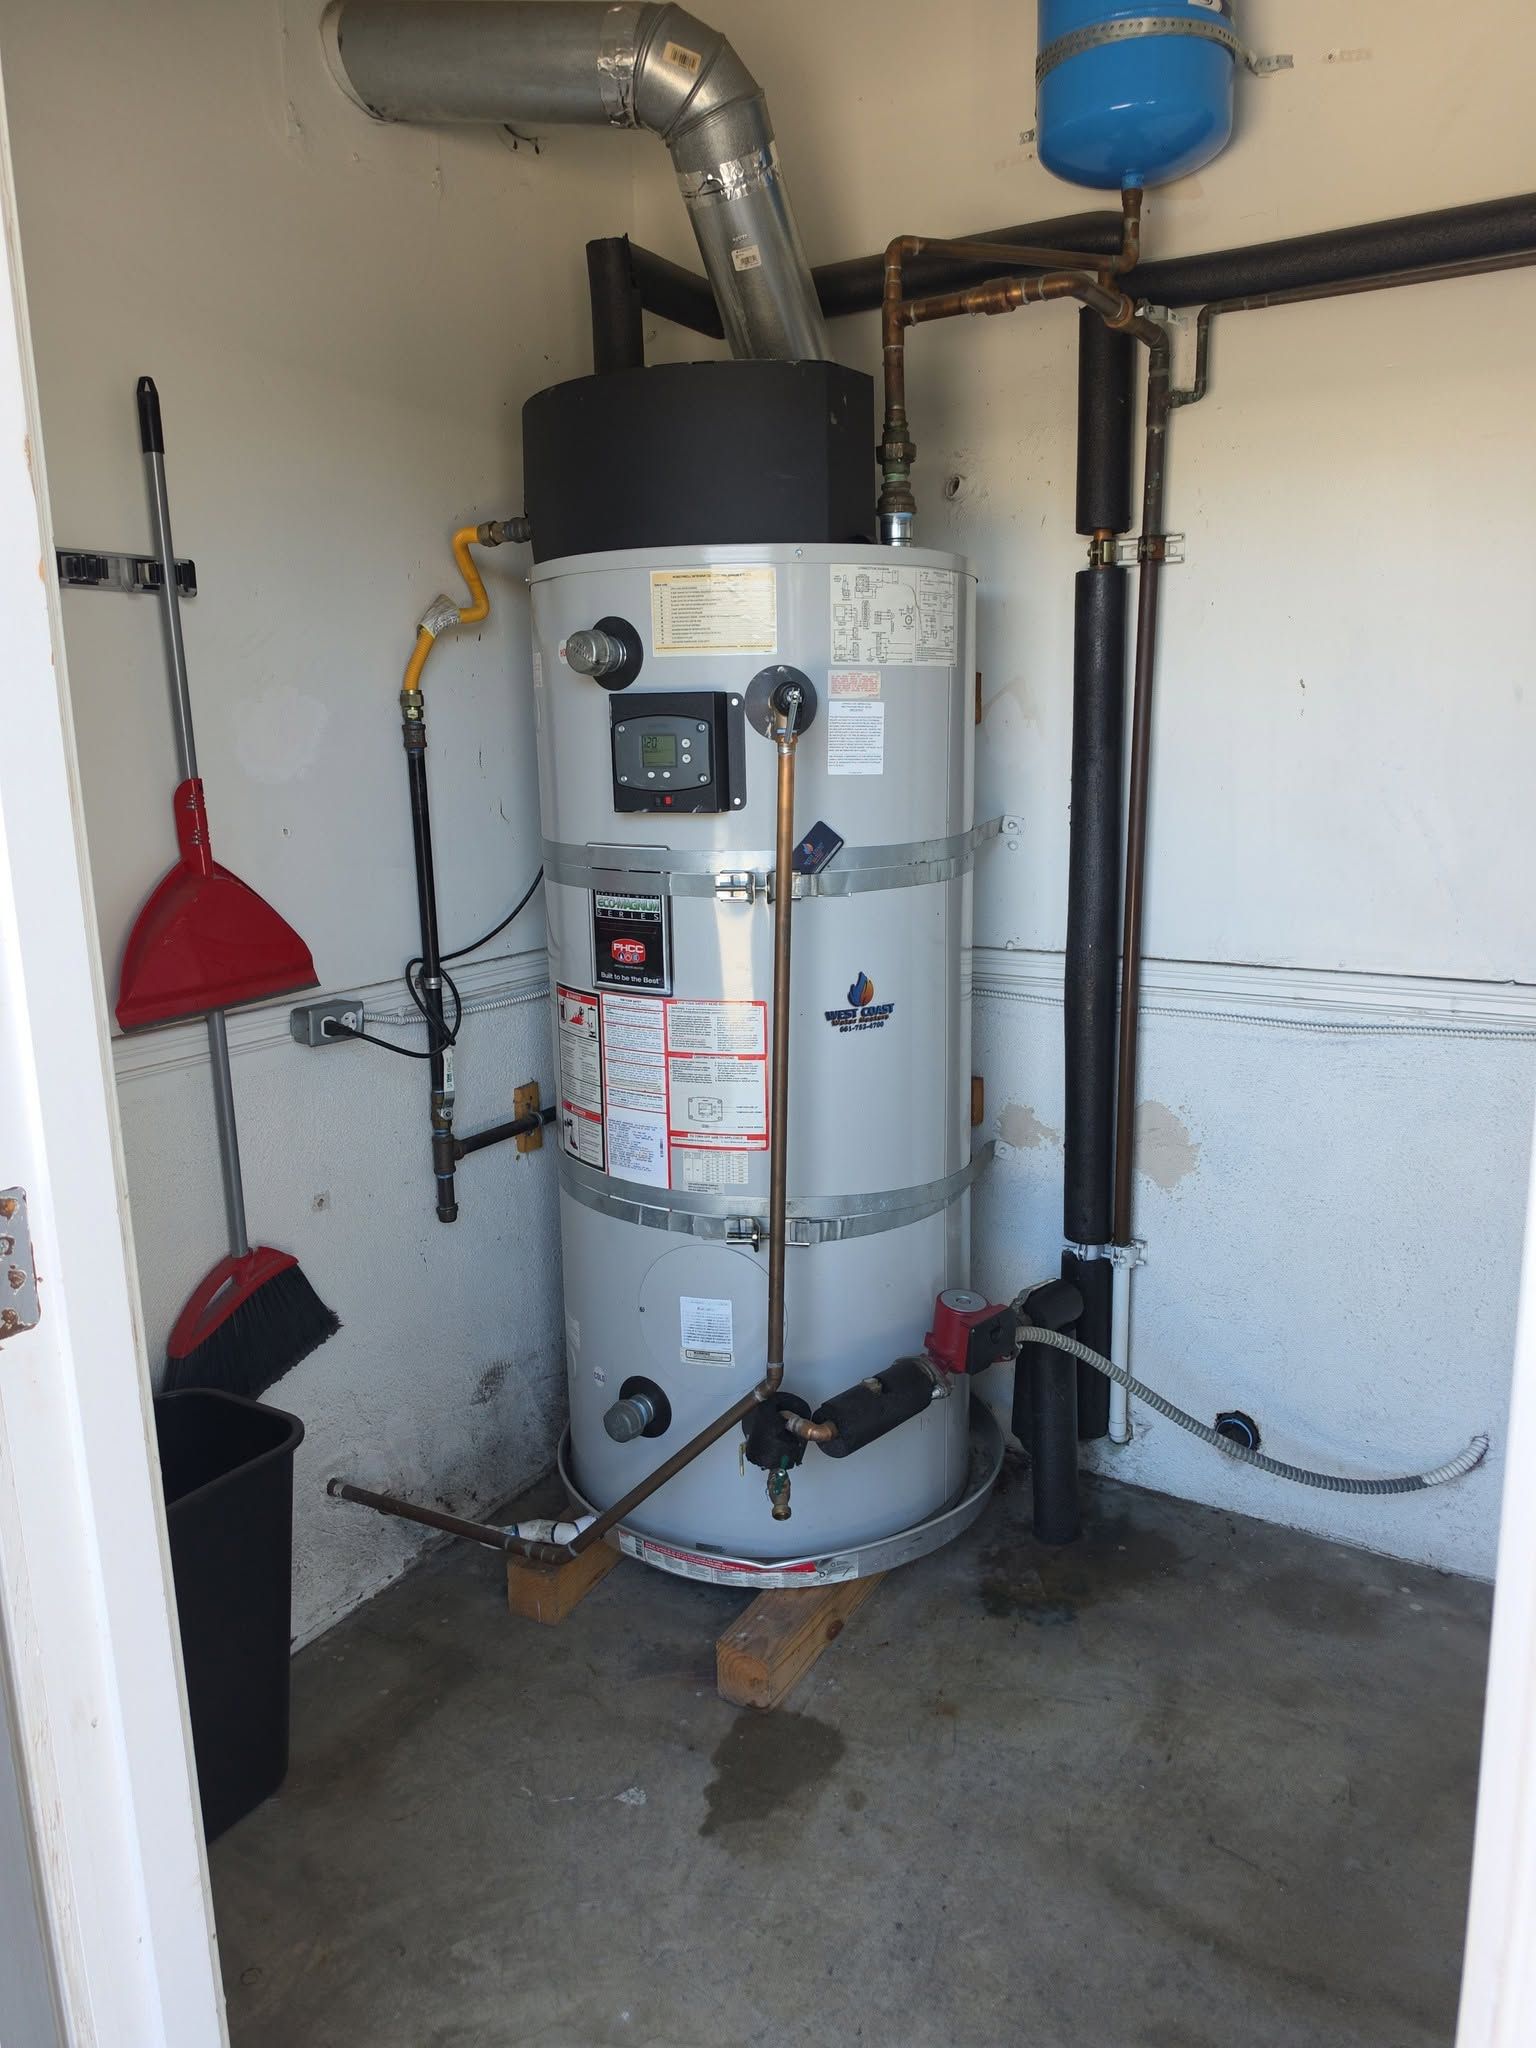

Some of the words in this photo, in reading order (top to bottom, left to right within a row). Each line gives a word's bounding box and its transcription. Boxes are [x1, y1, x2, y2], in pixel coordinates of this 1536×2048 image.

[644, 737, 658, 749] 120
[597, 910, 660, 920] SERIES
[613, 943, 644, 953] PHCC
[643, 976, 659, 984] Best
[824, 1008, 858, 1021] WEST
[860, 1003, 895, 1017] COAST
